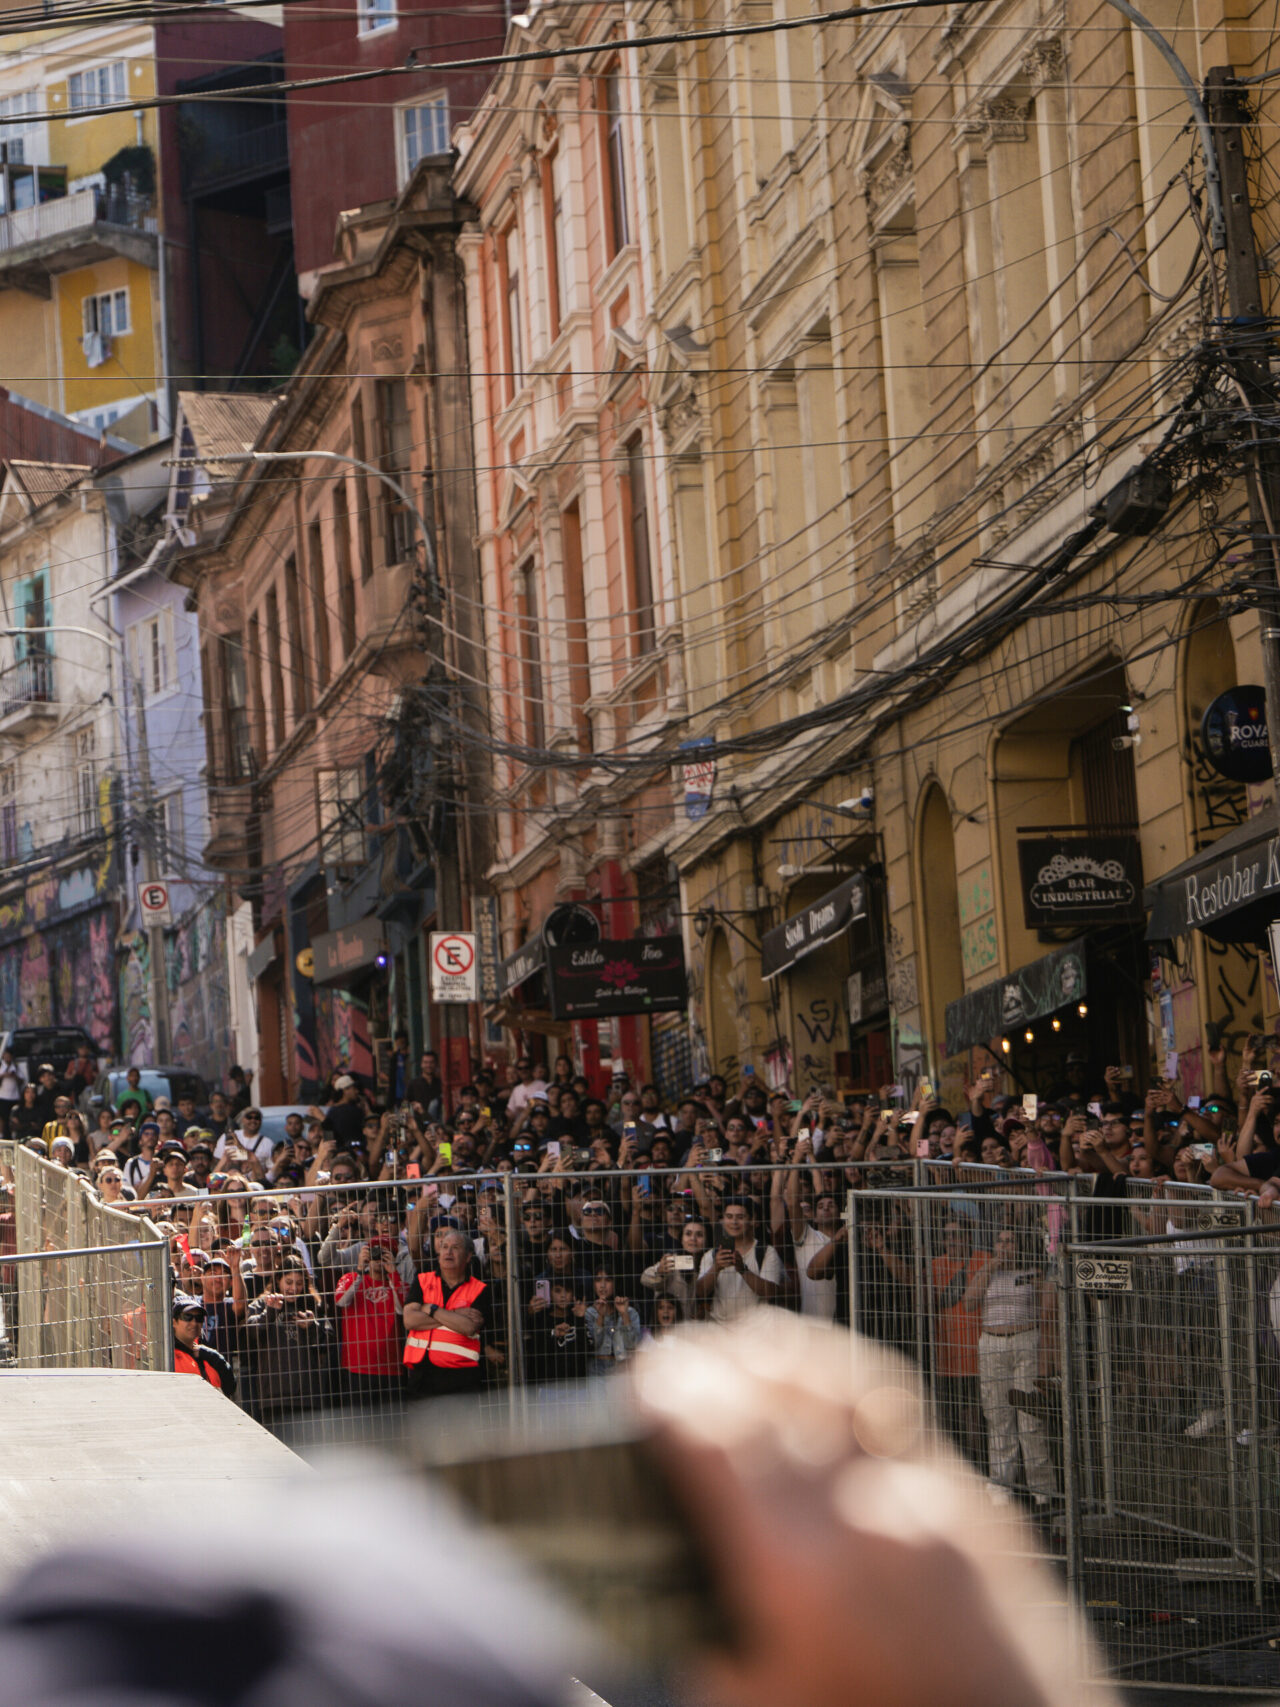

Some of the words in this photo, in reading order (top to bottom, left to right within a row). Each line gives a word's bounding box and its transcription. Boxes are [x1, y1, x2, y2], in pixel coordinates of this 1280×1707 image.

[1230, 724, 1269, 740] ROYA
[1067, 877, 1096, 888] BAR
[1185, 856, 1260, 925] Restobar
[1042, 889, 1124, 903] INDUSTRIAL
[785, 917, 805, 949] Sushi
[809, 902, 836, 935] Dreams
[571, 949, 605, 966] Estilo
[1097, 1262, 1128, 1274] VDS
